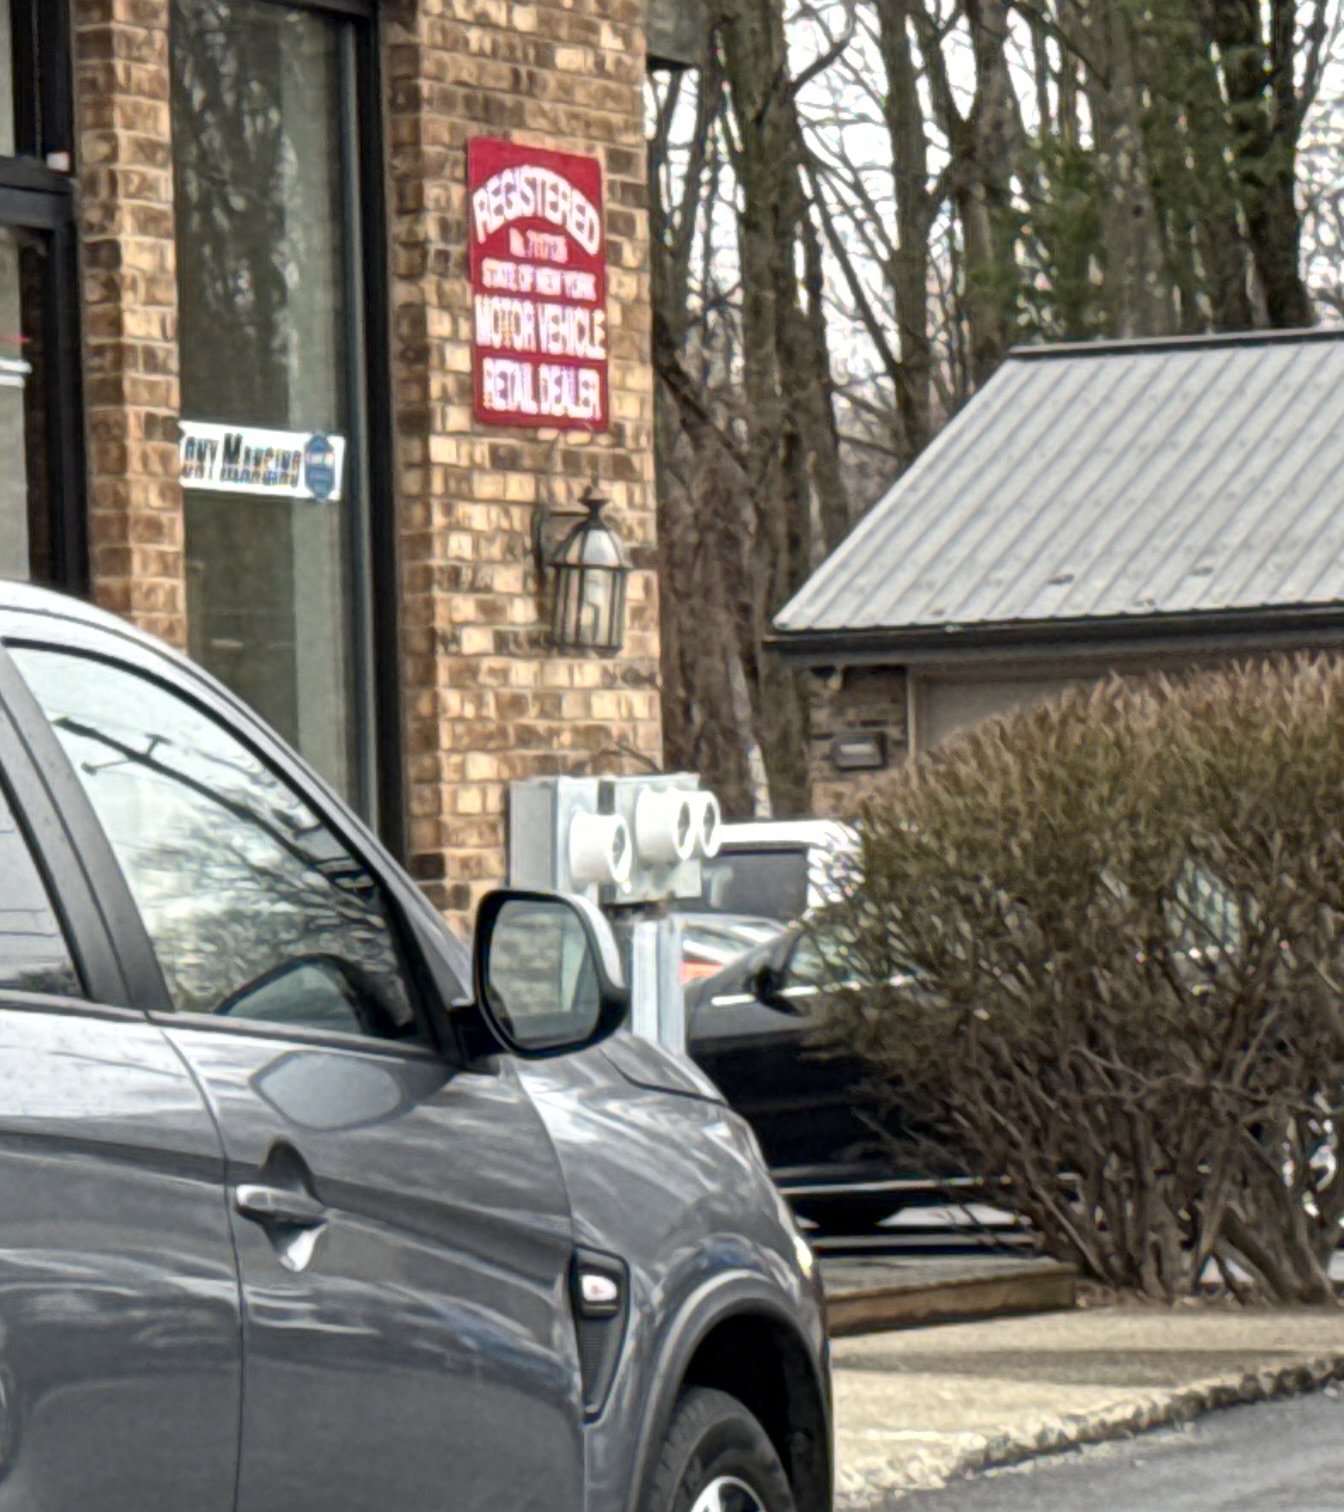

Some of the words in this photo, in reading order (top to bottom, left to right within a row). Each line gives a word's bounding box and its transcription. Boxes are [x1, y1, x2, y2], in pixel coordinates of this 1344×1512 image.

[472, 164, 601, 257] REGISTERED
[481, 257, 518, 292] STATE
[517, 264, 534, 292] OF
[535, 267, 562, 296] NEW
[475, 294, 537, 354] MOTOR
[537, 302, 606, 360] VEHICLE
[482, 357, 539, 415] RETAIL
[538, 362, 602, 420] DEALER
[181, 435, 220, 480] ONY
